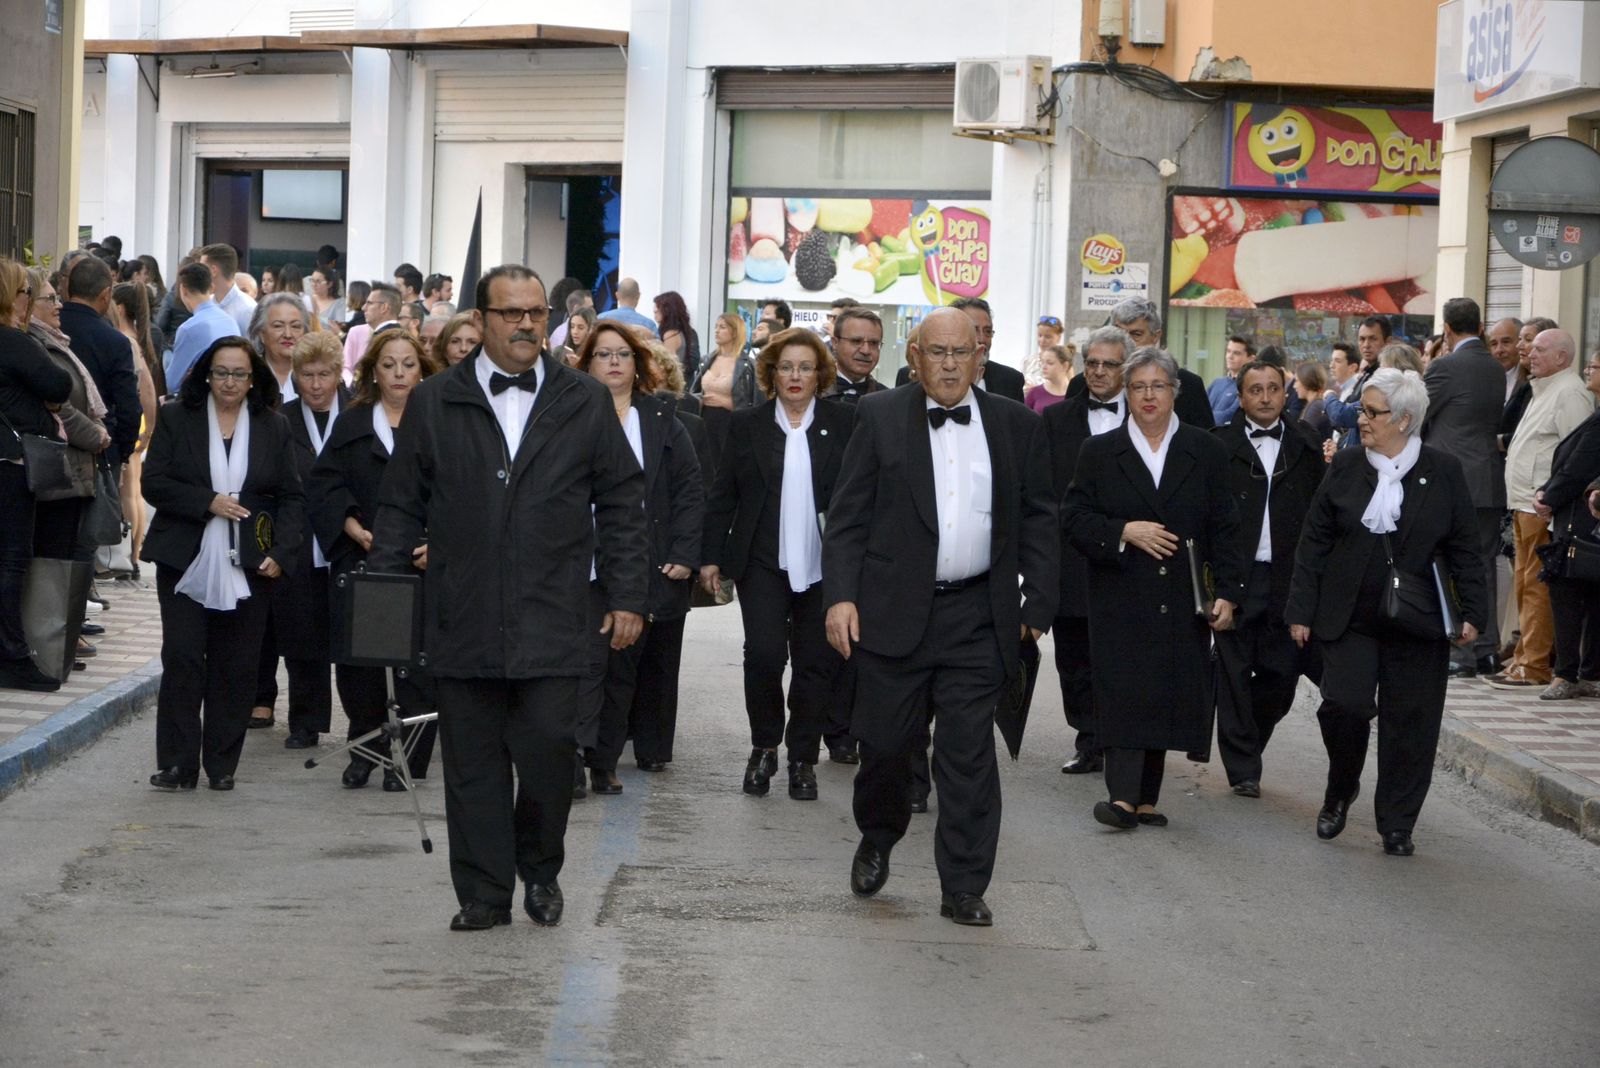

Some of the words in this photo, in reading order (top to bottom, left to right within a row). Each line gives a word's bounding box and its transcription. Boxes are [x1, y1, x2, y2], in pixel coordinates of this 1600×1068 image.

[1467, 0, 1513, 82] asisa
[1327, 136, 1376, 166] Don
[948, 218, 978, 240] Don
[1085, 240, 1121, 266] Lay's
[940, 262, 983, 287] Guay
[794, 312, 818, 321] HIELO
